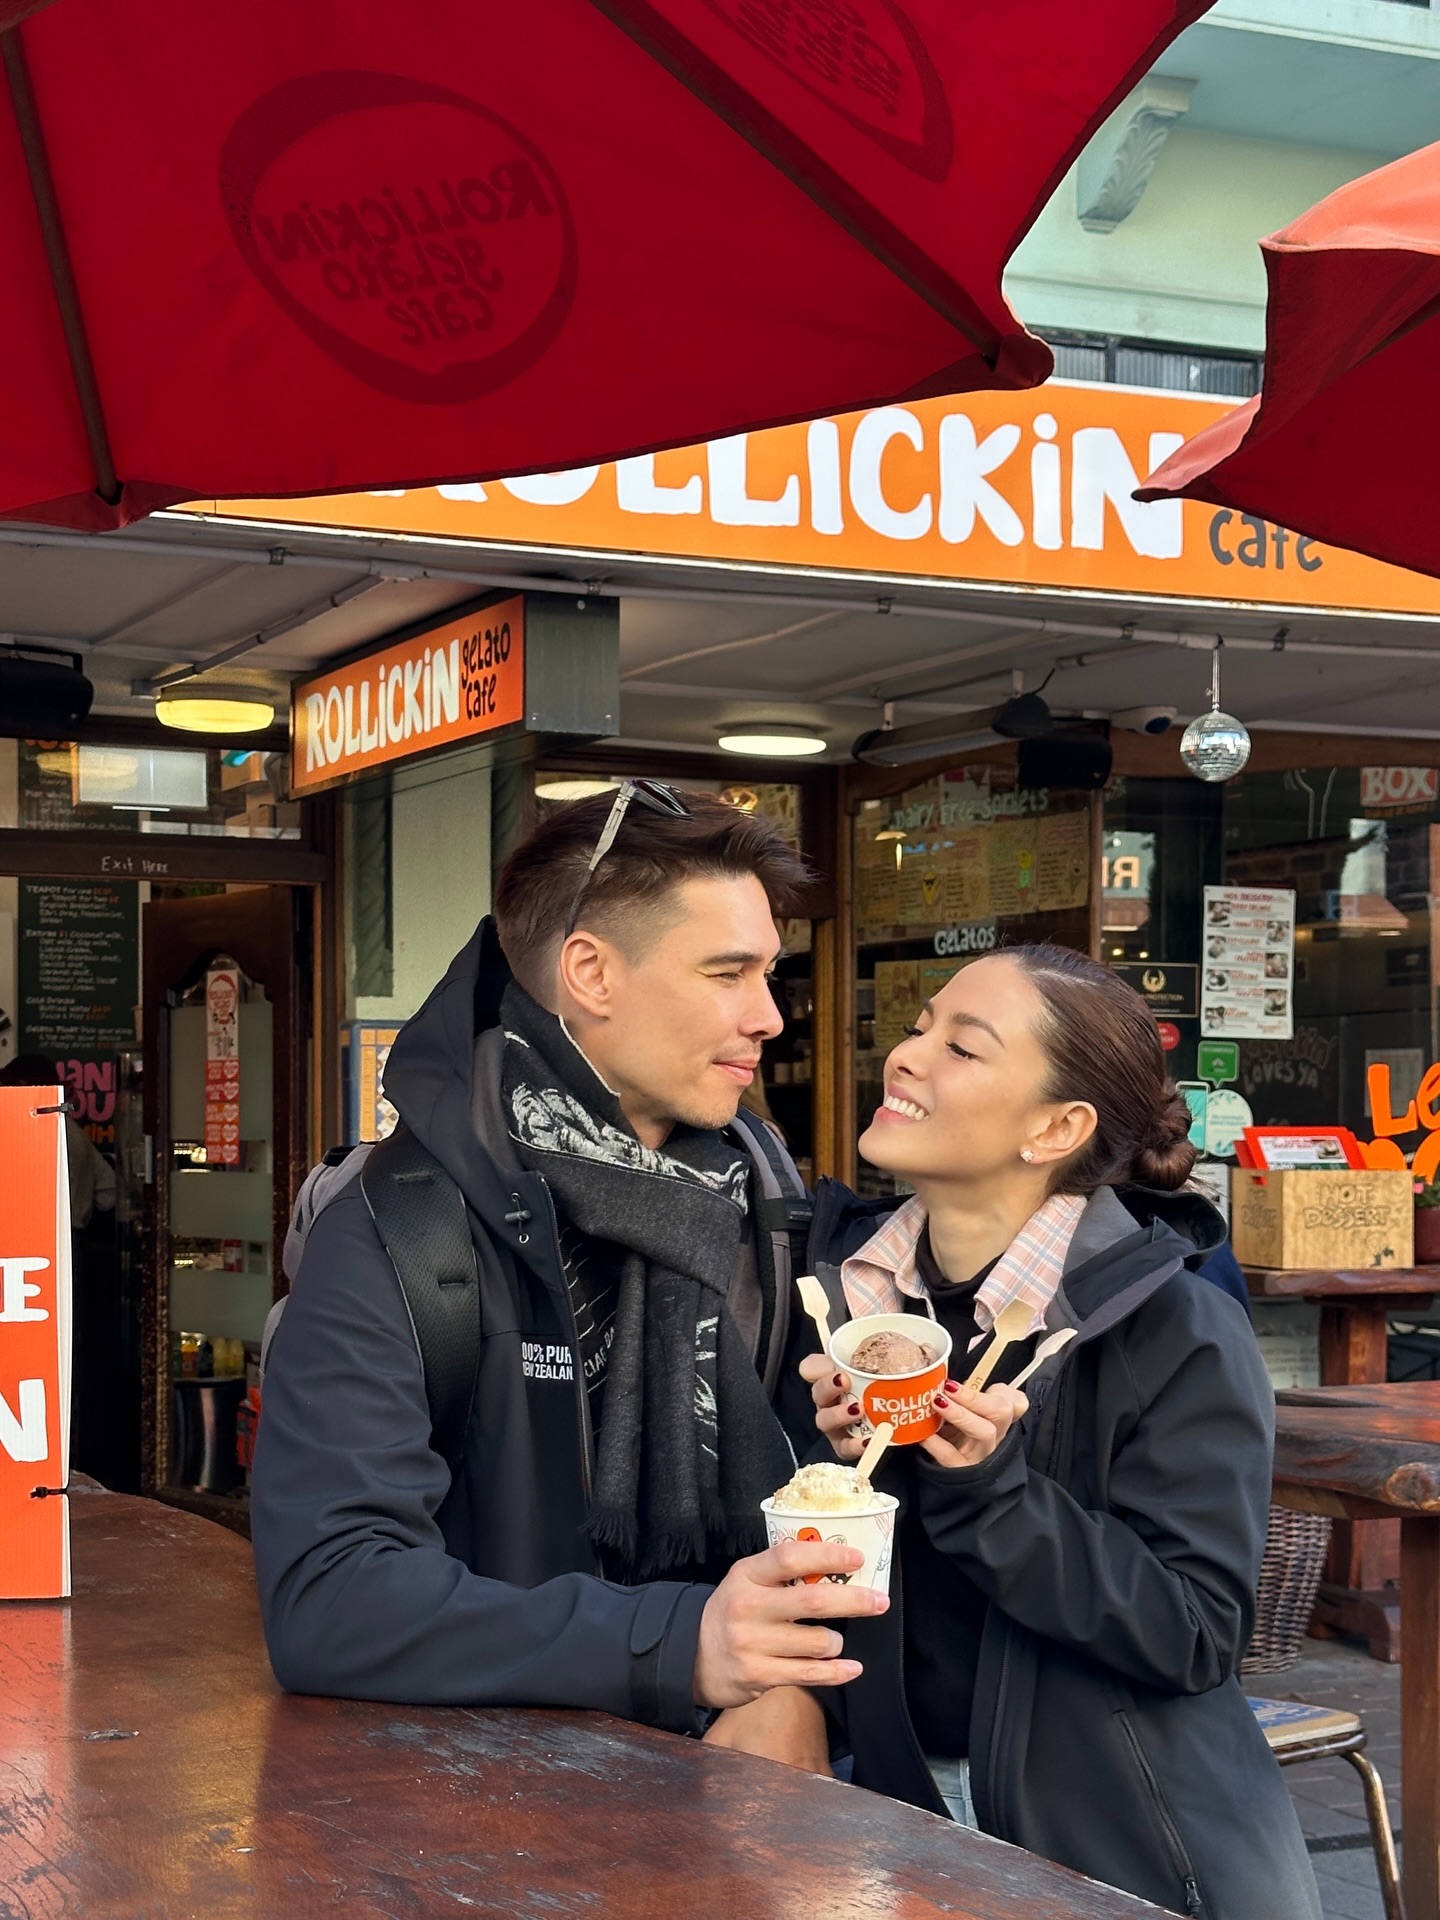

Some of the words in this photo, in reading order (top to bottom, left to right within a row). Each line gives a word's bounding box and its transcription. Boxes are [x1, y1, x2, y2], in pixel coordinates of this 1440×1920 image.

[466, 673, 497, 721] cafe
[1362, 766, 1434, 801] BOX
[101, 856, 133, 872] Exit
[1318, 1182, 1374, 1207] HOT
[521, 1341, 544, 1363] 00%
[546, 1344, 573, 1364] PUR
[535, 1362, 574, 1381] ZEALAN
